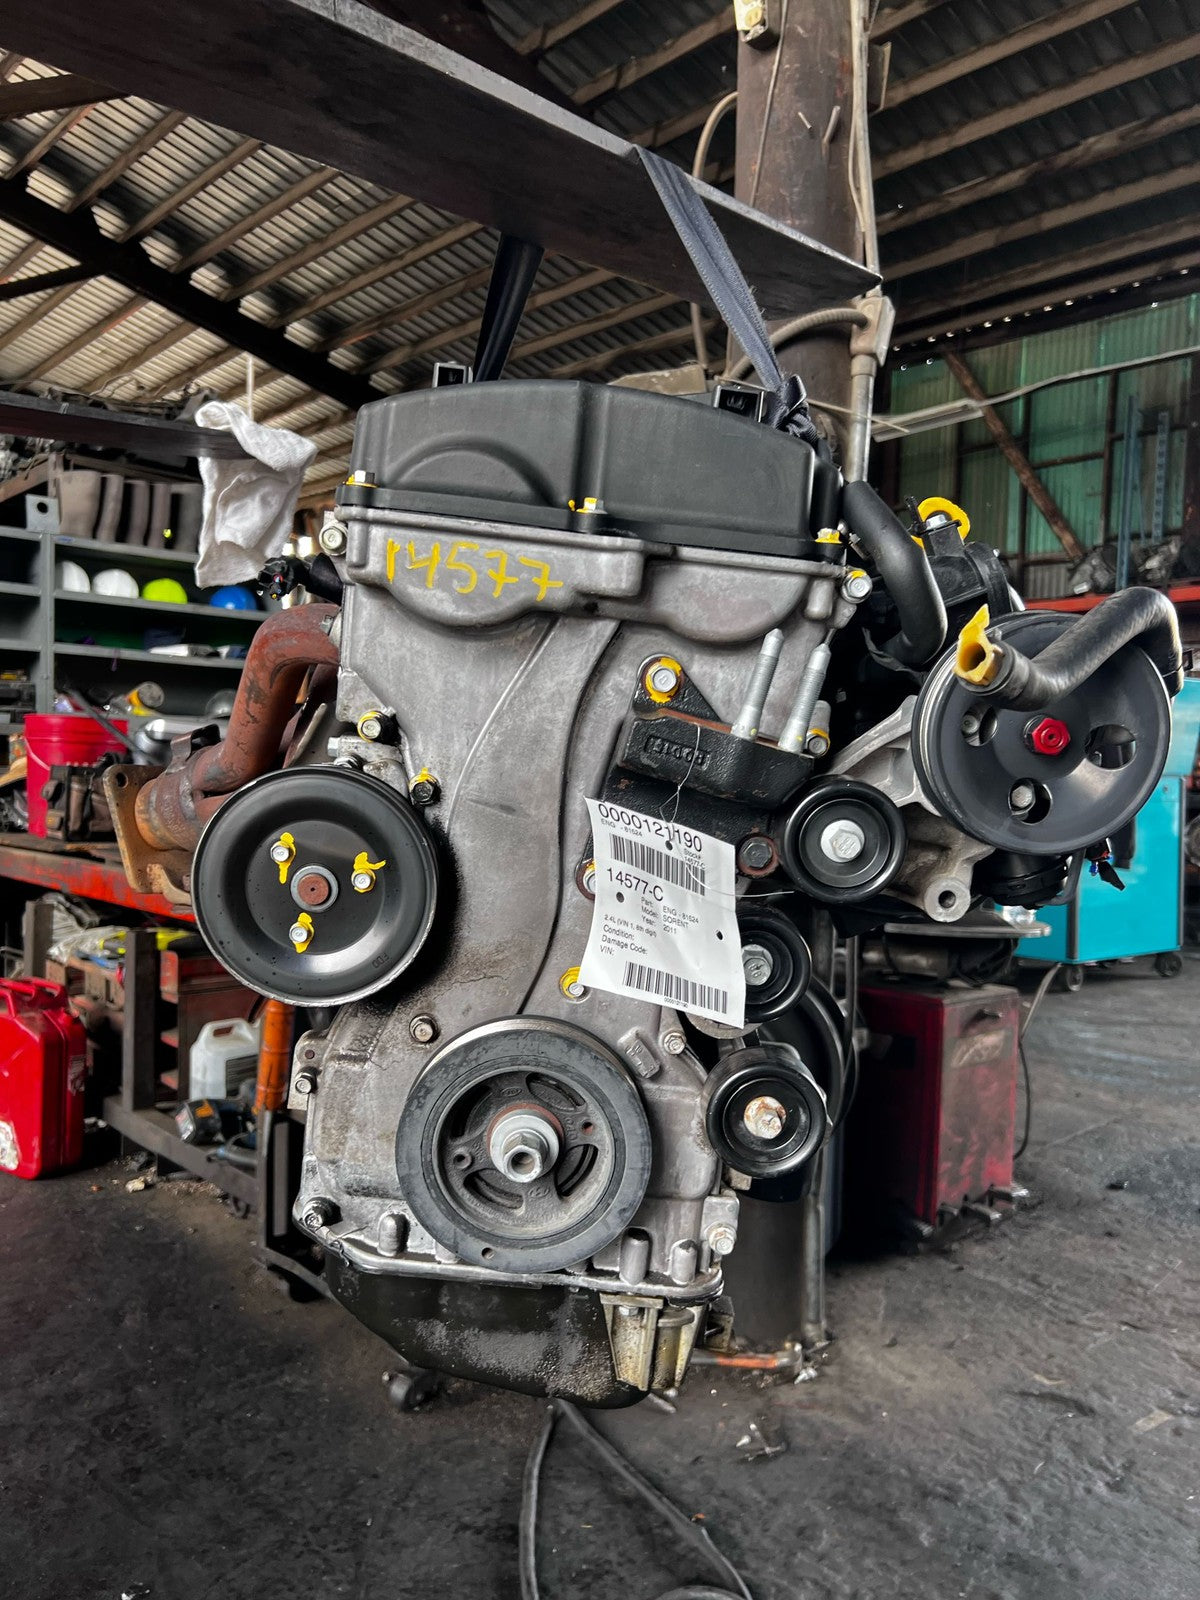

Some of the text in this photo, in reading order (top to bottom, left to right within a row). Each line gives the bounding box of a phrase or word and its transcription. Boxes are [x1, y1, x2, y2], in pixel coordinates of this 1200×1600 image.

[386, 538, 564, 602] 14577
[598, 803, 702, 852] 0000121190
[684, 857, 706, 870] 14577-C
[607, 868, 664, 902] 14577-C
[641, 896, 654, 908] Part:
[663, 906, 677, 917] ENG
[641, 906, 689, 929] Model: SORENT
[642, 915, 677, 934] Year: 2011
[603, 924, 635, 941] Condition:
[600, 945, 615, 956] VIN:
[602, 935, 649, 955] Damage Code:
